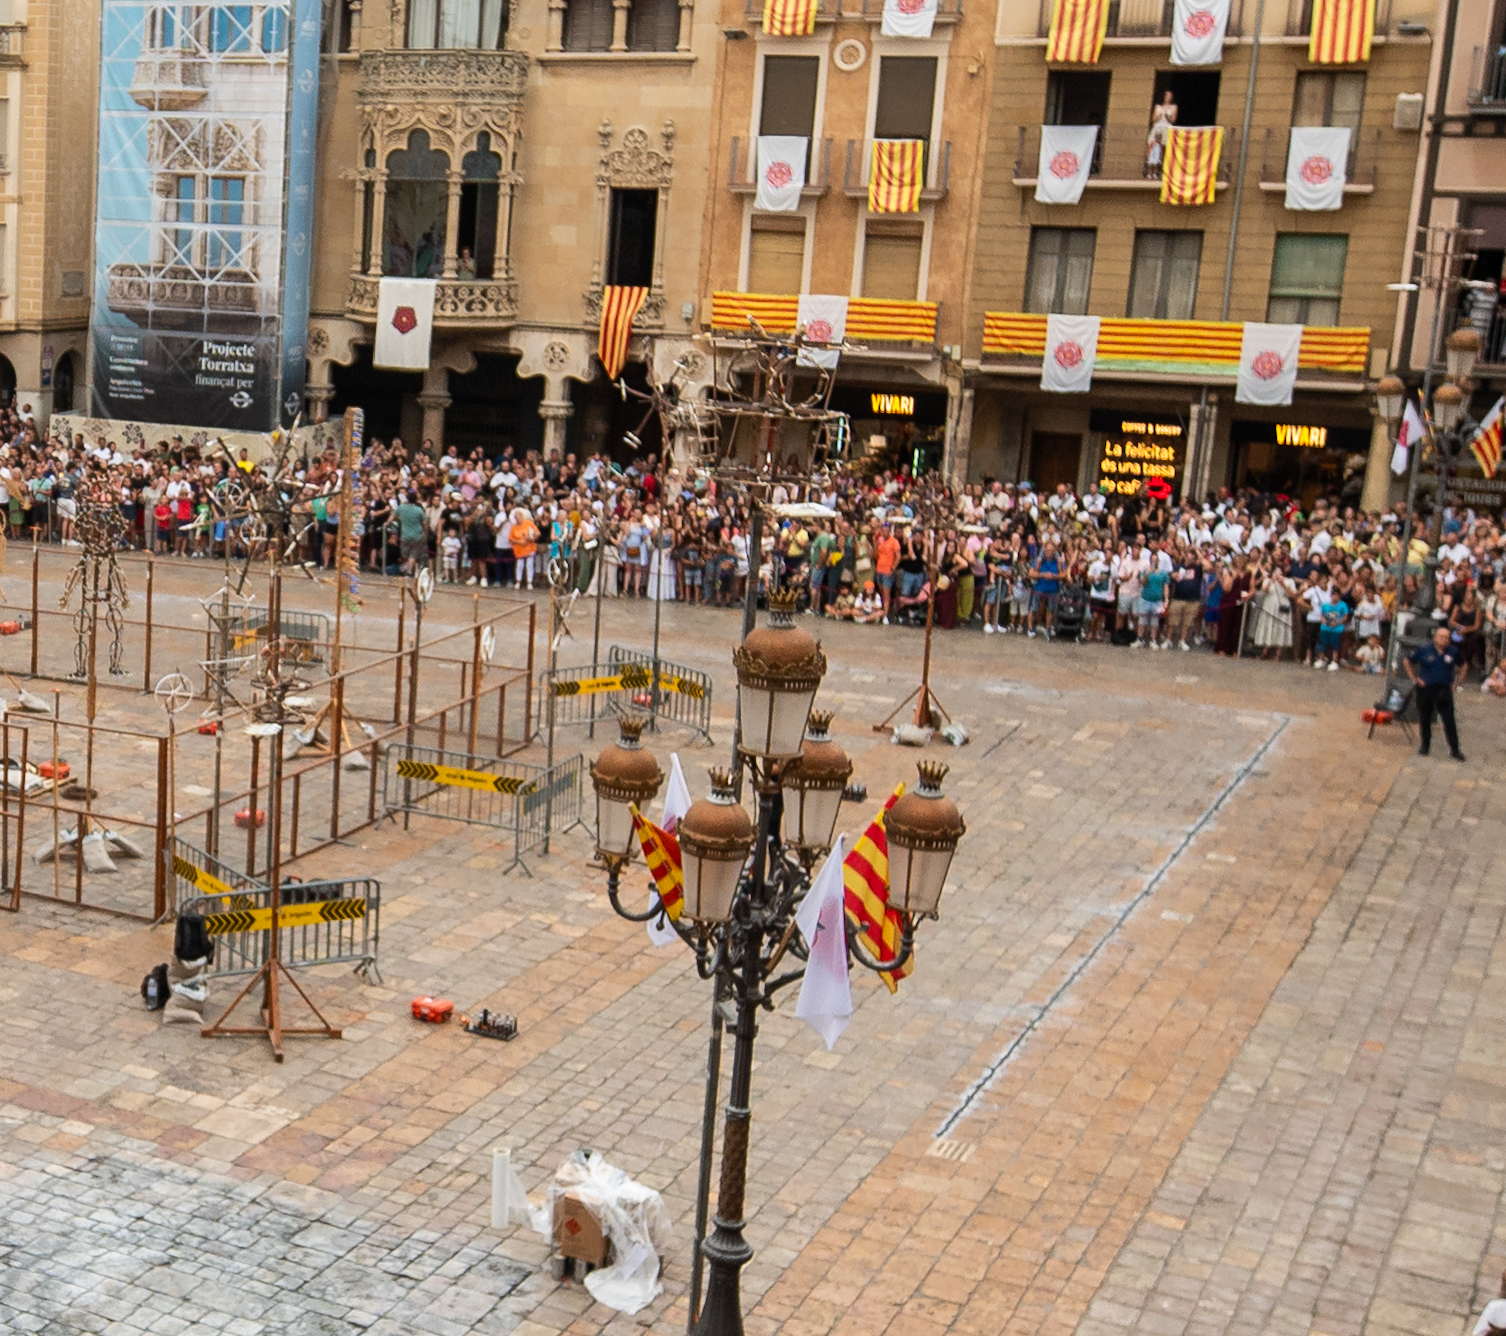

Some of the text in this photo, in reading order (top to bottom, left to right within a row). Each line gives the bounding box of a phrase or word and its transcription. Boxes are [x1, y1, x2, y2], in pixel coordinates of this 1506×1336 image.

[203, 340, 256, 357] Projecte
[198, 357, 255, 373] Torratxa
[195, 374, 254, 389] finançat per
[871, 393, 914, 415] VIVARI
[1276, 424, 1327, 448] VIVARI
[1105, 440, 1175, 461] La felicitat
[1101, 458, 1176, 479] és una tassa
